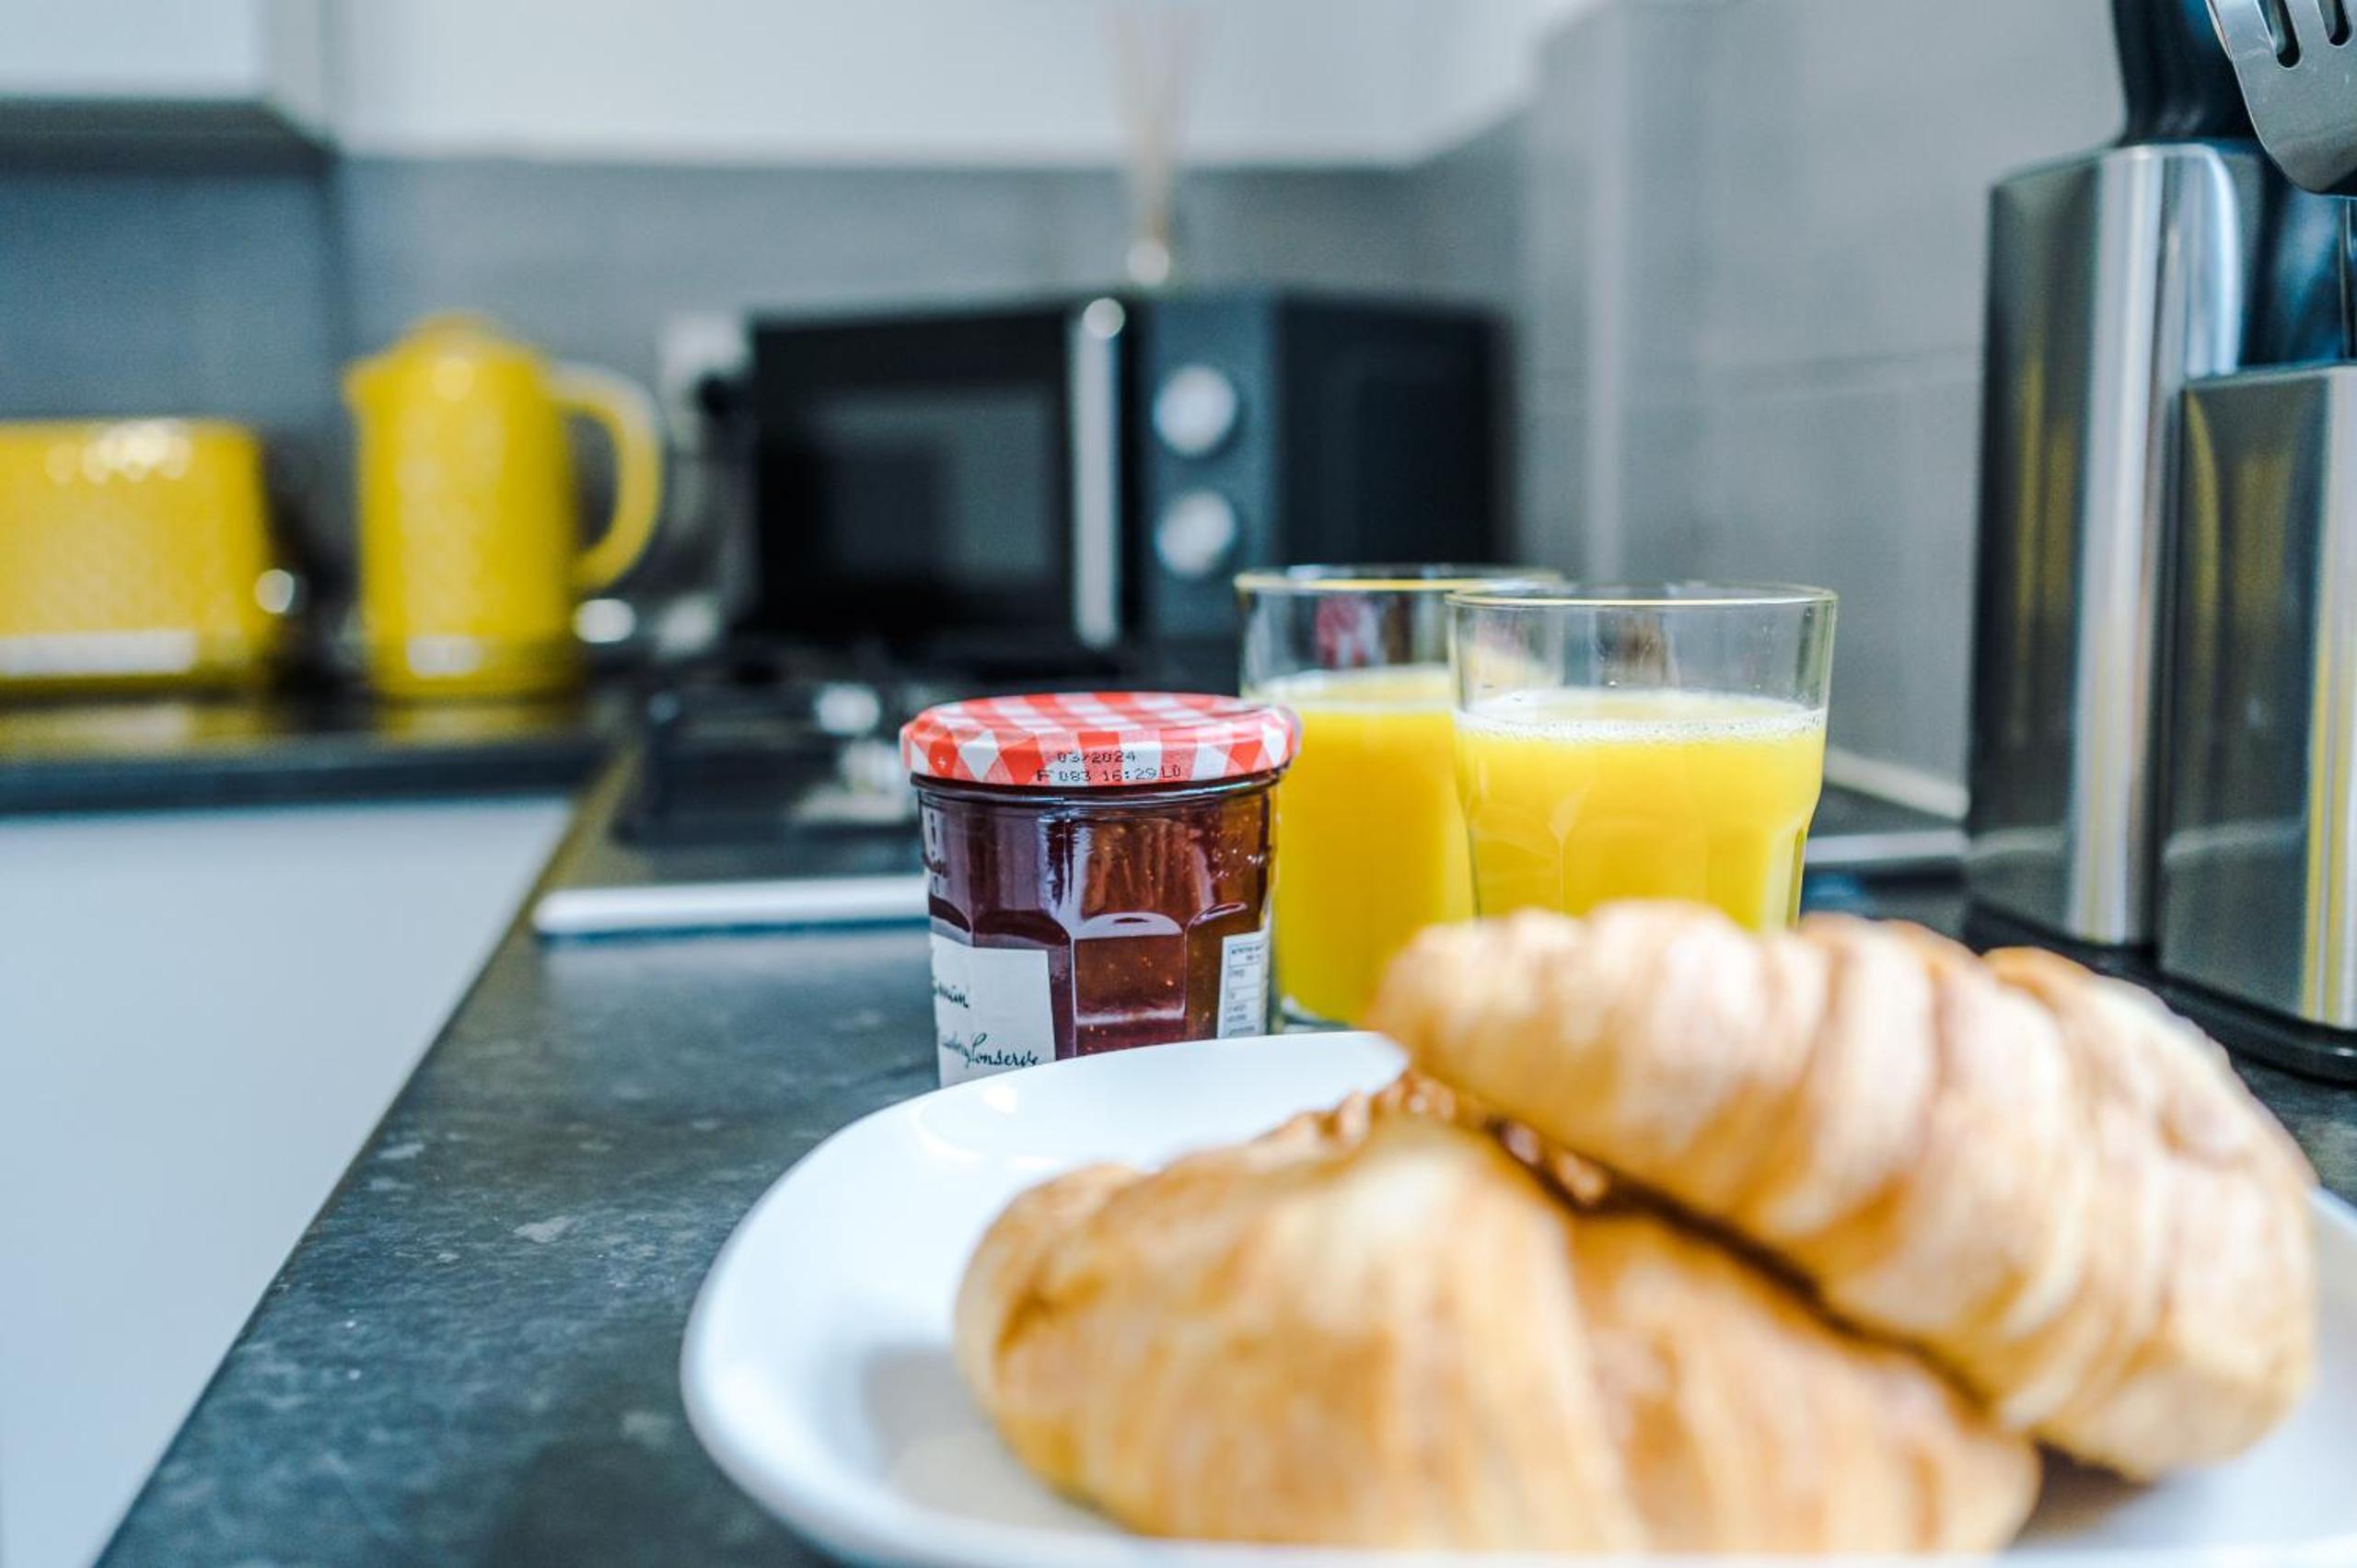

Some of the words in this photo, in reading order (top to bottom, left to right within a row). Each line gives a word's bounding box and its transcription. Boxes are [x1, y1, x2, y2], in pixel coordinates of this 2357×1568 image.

[1057, 750, 1135, 763] 03/2024
[1059, 769, 1091, 782] 083
[1103, 767, 1157, 782] 16:29
